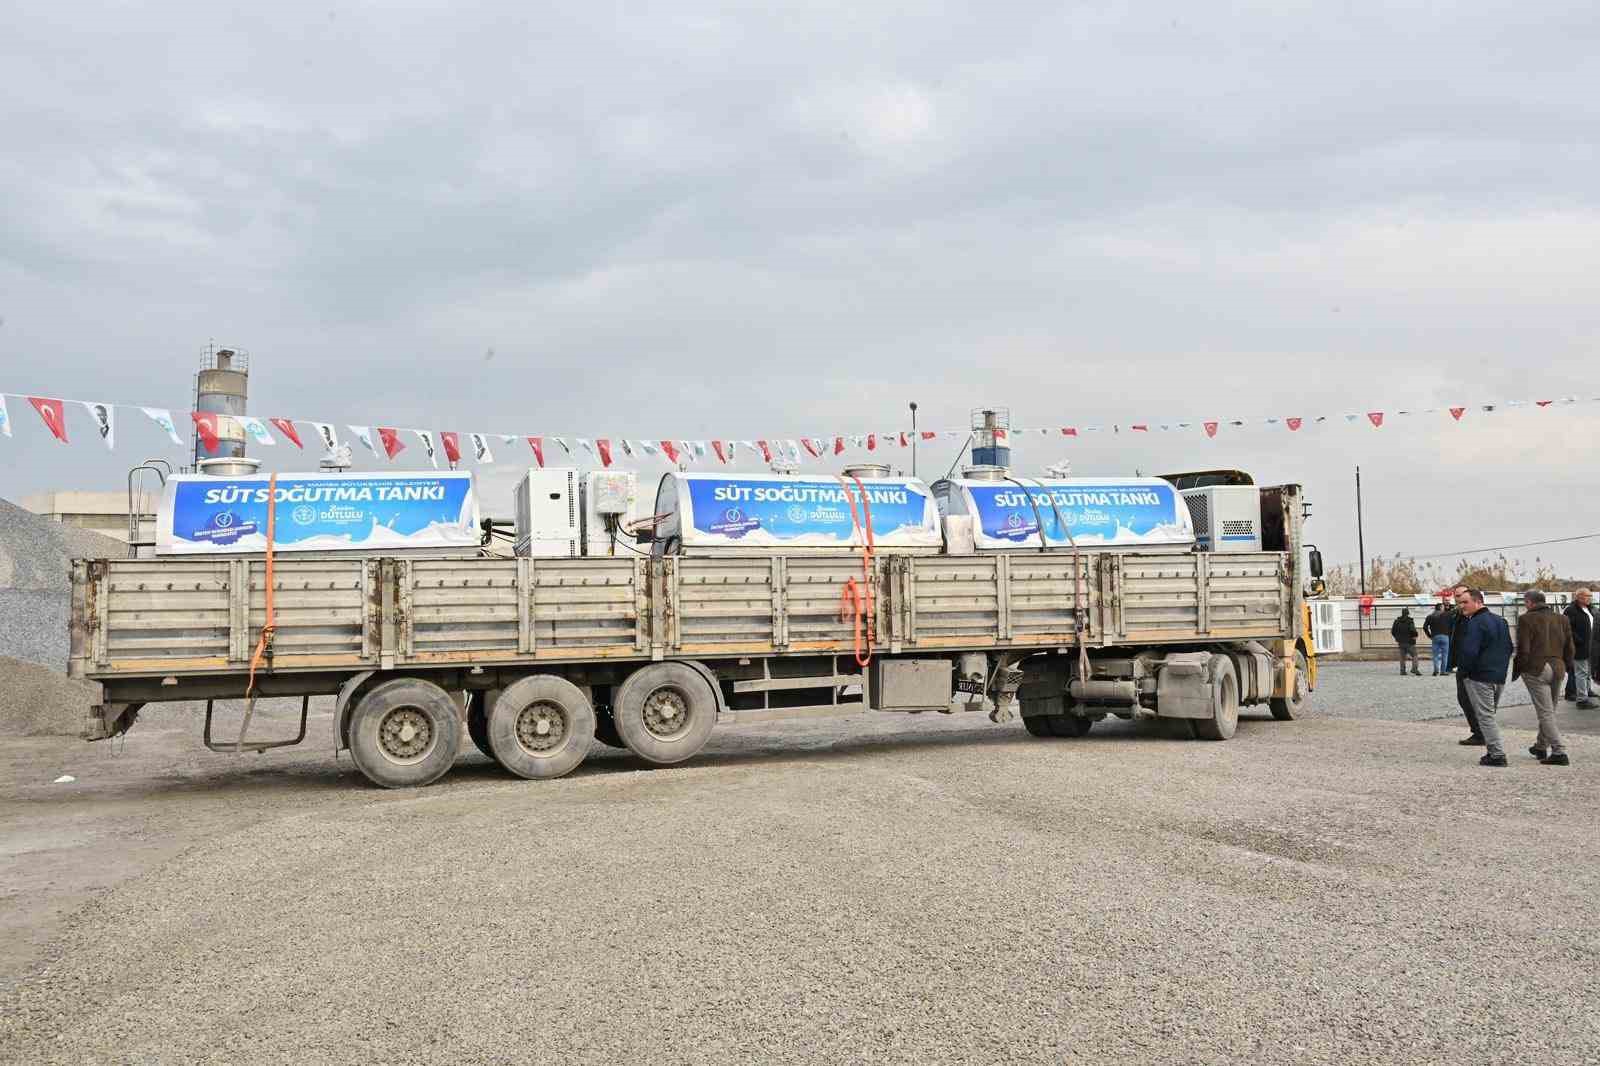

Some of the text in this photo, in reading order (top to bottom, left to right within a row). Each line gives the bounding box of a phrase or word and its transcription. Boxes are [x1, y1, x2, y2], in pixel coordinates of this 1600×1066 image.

[204, 484, 446, 504] SÜT SOĞUTMA TANKI
[714, 484, 752, 501] SÜT
[754, 484, 849, 503] SOĞUTMA
[850, 488, 907, 504] TANKI
[994, 490, 1027, 507] SÜT
[1108, 492, 1161, 506] TANKI
